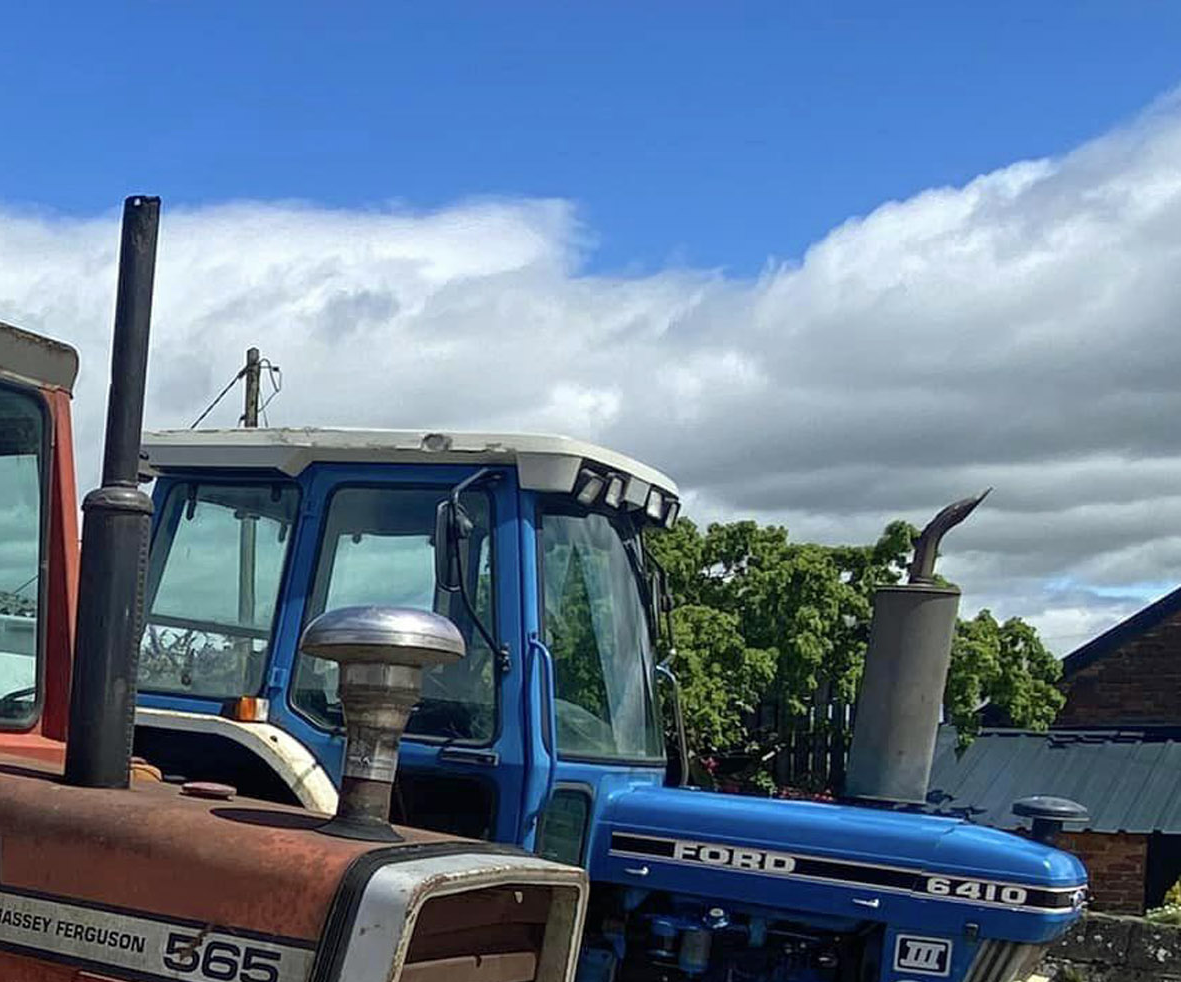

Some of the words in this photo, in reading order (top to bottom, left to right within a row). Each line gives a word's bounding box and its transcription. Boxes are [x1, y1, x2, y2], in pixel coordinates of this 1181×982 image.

[673, 840, 796, 874] FORD
[926, 877, 1028, 905] 6410
[55, 919, 146, 954] FERGUSON
